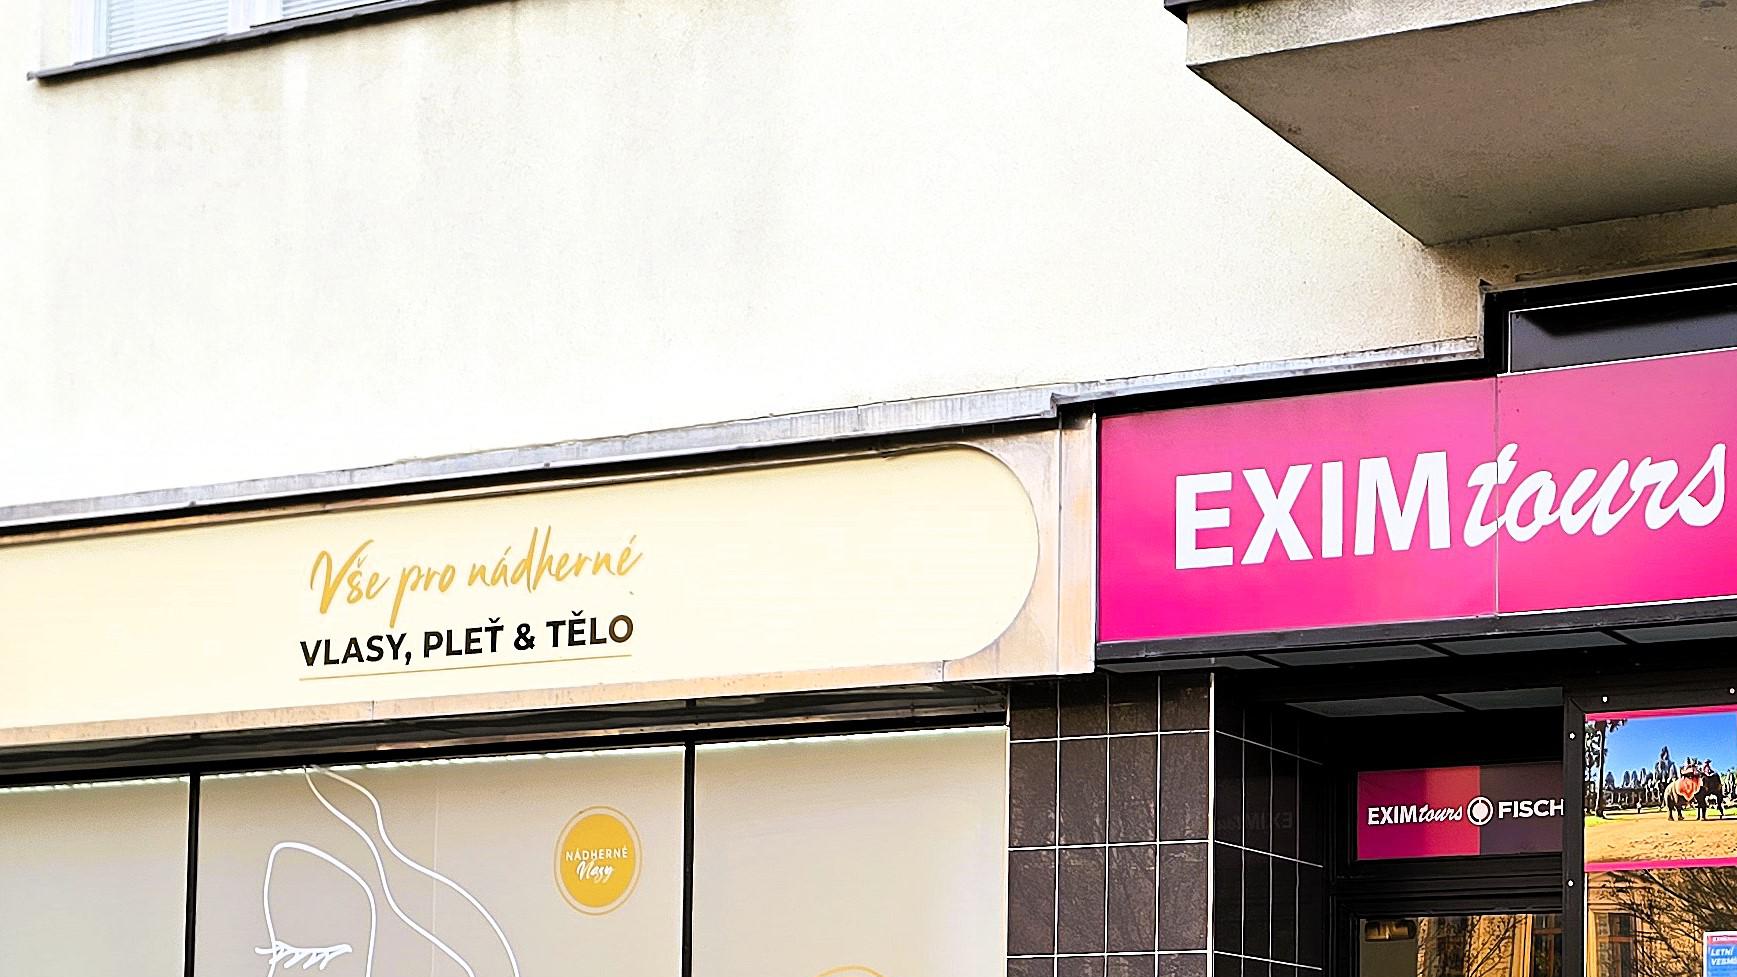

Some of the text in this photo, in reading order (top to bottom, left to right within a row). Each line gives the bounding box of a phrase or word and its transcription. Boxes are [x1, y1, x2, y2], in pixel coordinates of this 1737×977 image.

[310, 525, 643, 629] Vše pro nádherné
[300, 610, 634, 667] VLASY, PLEŤ & TĚLO
[565, 847, 628, 862] NÁDHERNÉ
[576, 859, 614, 884] Vlasy
